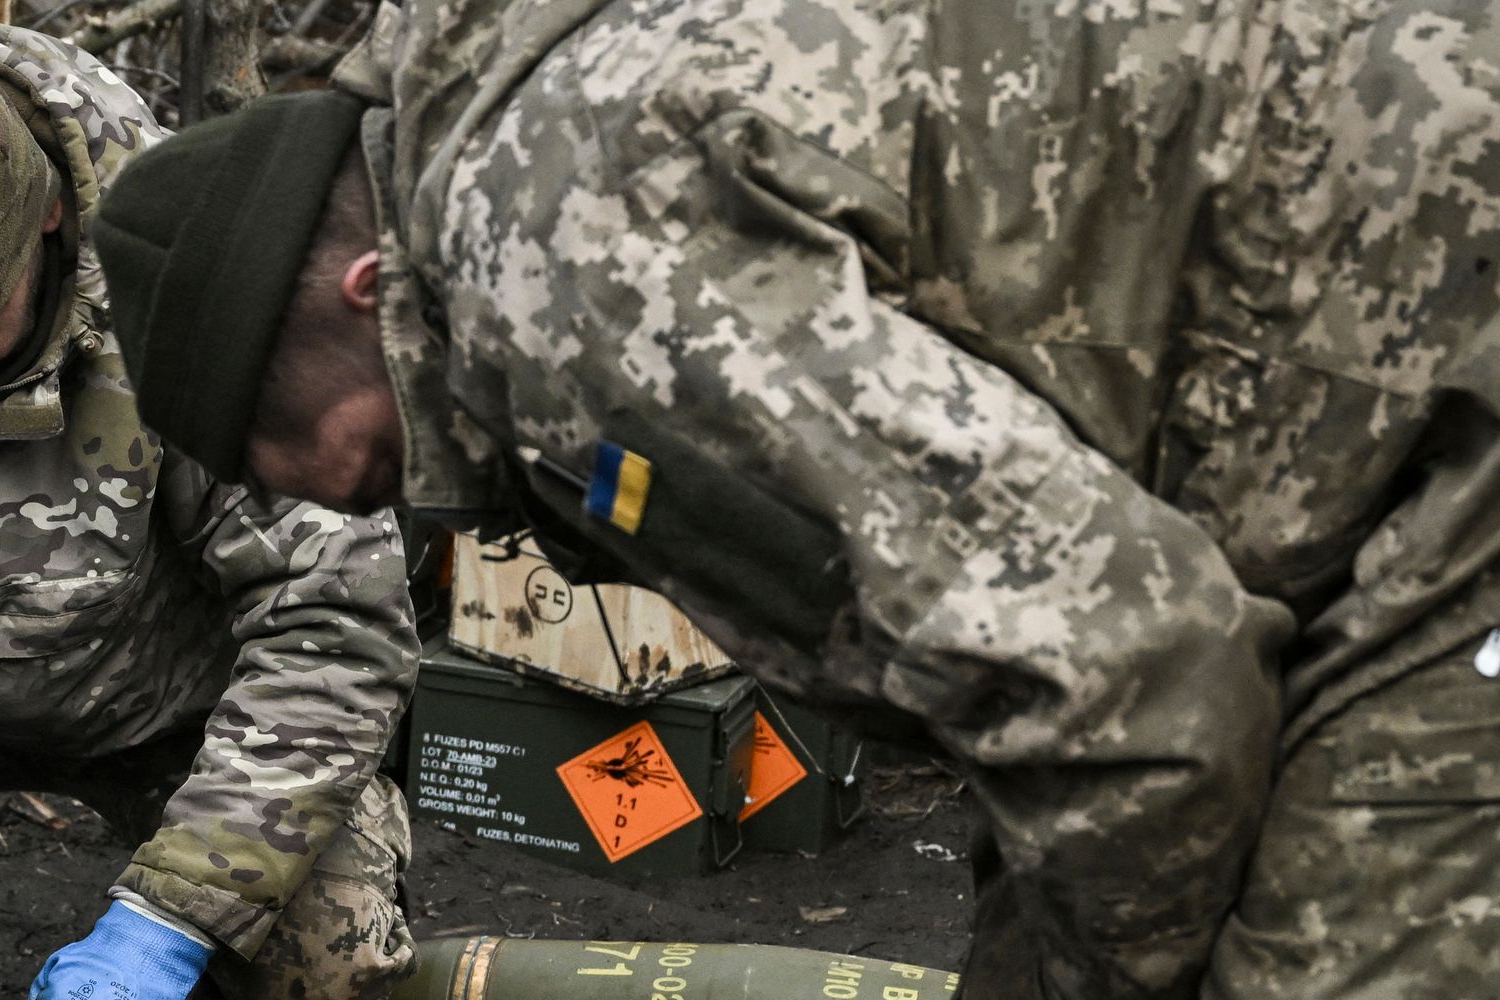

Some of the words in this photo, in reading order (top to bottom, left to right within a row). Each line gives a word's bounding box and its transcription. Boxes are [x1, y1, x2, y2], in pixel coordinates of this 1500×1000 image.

[422, 747, 442, 757] LOT
[434, 734, 467, 747] FUZES
[469, 740, 483, 750] PD
[485, 742, 511, 754] M557
[476, 781, 488, 792] kg
[616, 793, 638, 810] 1.1
[418, 798, 454, 812] GROSS
[456, 804, 499, 819] WEIGHT:
[514, 814, 526, 825] kg
[614, 814, 627, 829] D
[514, 833, 580, 852] DETONATING
[110, 981, 130, 993] 2020
